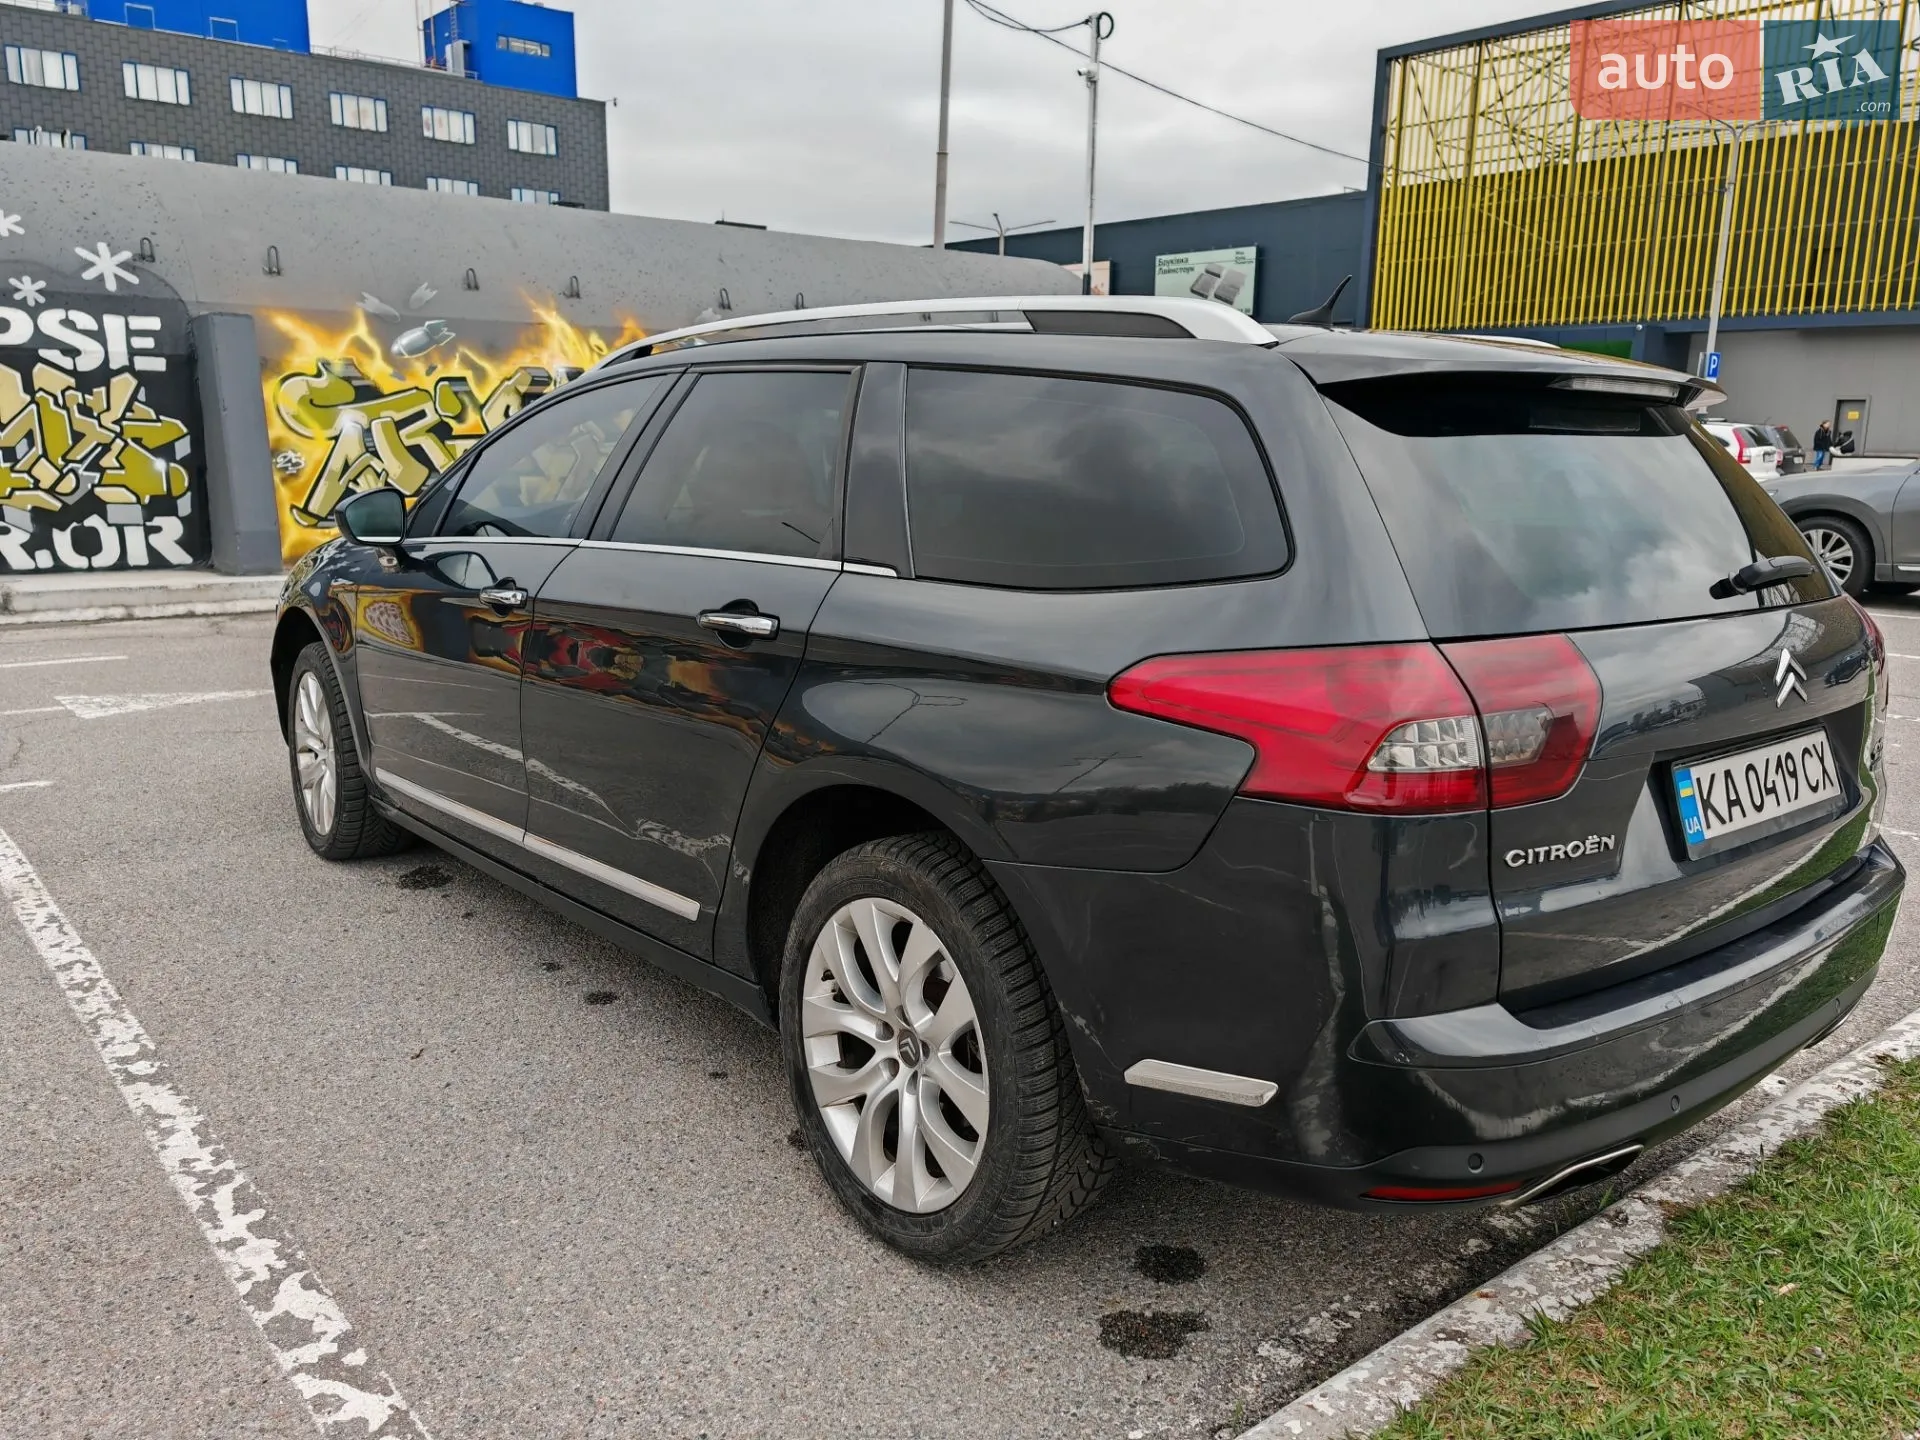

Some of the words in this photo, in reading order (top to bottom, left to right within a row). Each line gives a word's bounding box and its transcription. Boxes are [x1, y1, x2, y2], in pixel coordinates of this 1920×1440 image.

[1709, 355, 1718, 375] P
[1744, 752, 1799, 813] 0419
[1685, 817, 1703, 836] UA
[1504, 834, 1616, 868] CITROËN
